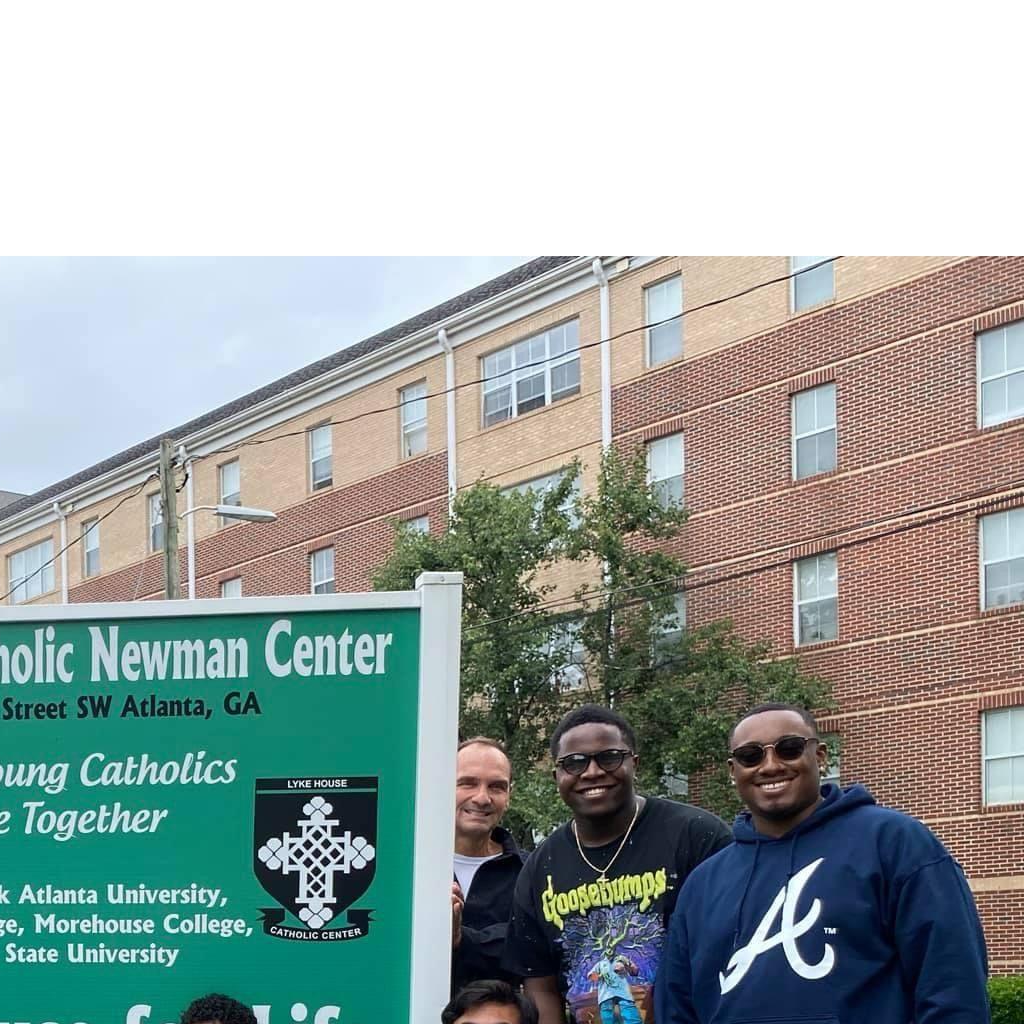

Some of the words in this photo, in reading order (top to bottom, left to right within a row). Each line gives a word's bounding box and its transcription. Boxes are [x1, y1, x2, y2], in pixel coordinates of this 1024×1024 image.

[88, 625, 249, 682] Newman
[264, 619, 393, 678] Center
[2, 697, 68, 721] Street
[76, 694, 113, 719] SW
[119, 694, 213, 720] Atlanta,
[223, 691, 262, 716] GA
[79, 750, 238, 787] Catholics
[287, 780, 312, 789] LYKE
[314, 779, 348, 788] HOUSE
[22, 801, 169, 842] Together
[18, 884, 98, 905] Atlanta
[107, 883, 228, 908] University,
[542, 867, 666, 931] Goosebumps
[34, 913, 155, 934] Morehouse
[163, 913, 253, 938] College,
[270, 926, 318, 939] CATHOLIC
[321, 927, 362, 939] CENTER
[824, 927, 837, 935] TM
[5, 942, 59, 963] State
[67, 942, 179, 967] University
